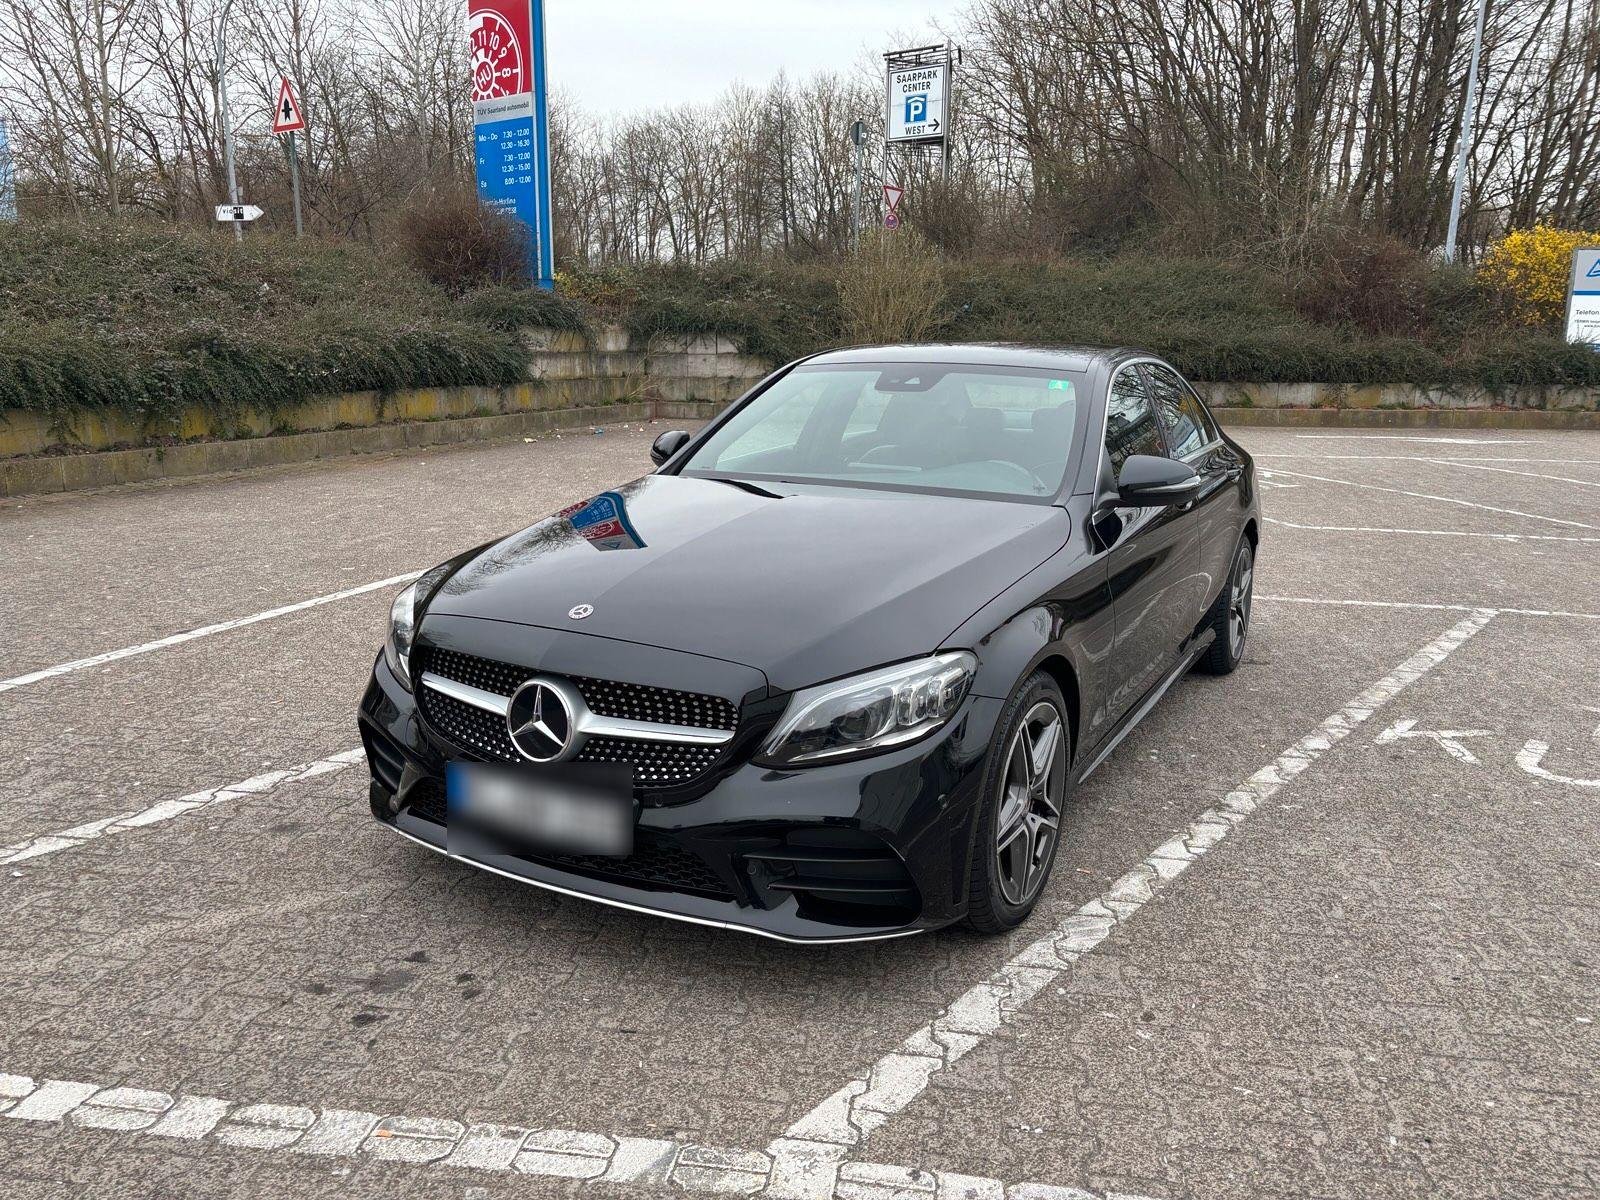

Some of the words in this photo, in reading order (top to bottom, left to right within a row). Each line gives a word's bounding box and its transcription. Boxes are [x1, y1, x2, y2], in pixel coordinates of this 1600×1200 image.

[489, 31, 500, 50] 10
[498, 46, 507, 58] 9
[477, 64, 492, 89] HU
[501, 67, 511, 78] 8
[896, 69, 938, 84] SAARPARK
[902, 81, 931, 93] CENTER
[487, 104, 506, 115] Saarland
[507, 101, 530, 111] automobil
[909, 101, 923, 121] P
[478, 134, 487, 142] Mo
[490, 132, 498, 140] Do
[503, 130, 513, 139] 7.30
[517, 128, 530, 137] 12.00
[905, 125, 926, 135] WEST
[501, 141, 514, 149] 12.30
[479, 157, 485, 165] Fr
[504, 153, 514, 162] 7.30
[518, 151, 531, 160] 12.00
[502, 164, 515, 173] 12.30
[518, 162, 531, 171] 15.00
[518, 175, 531, 184] 12.00
